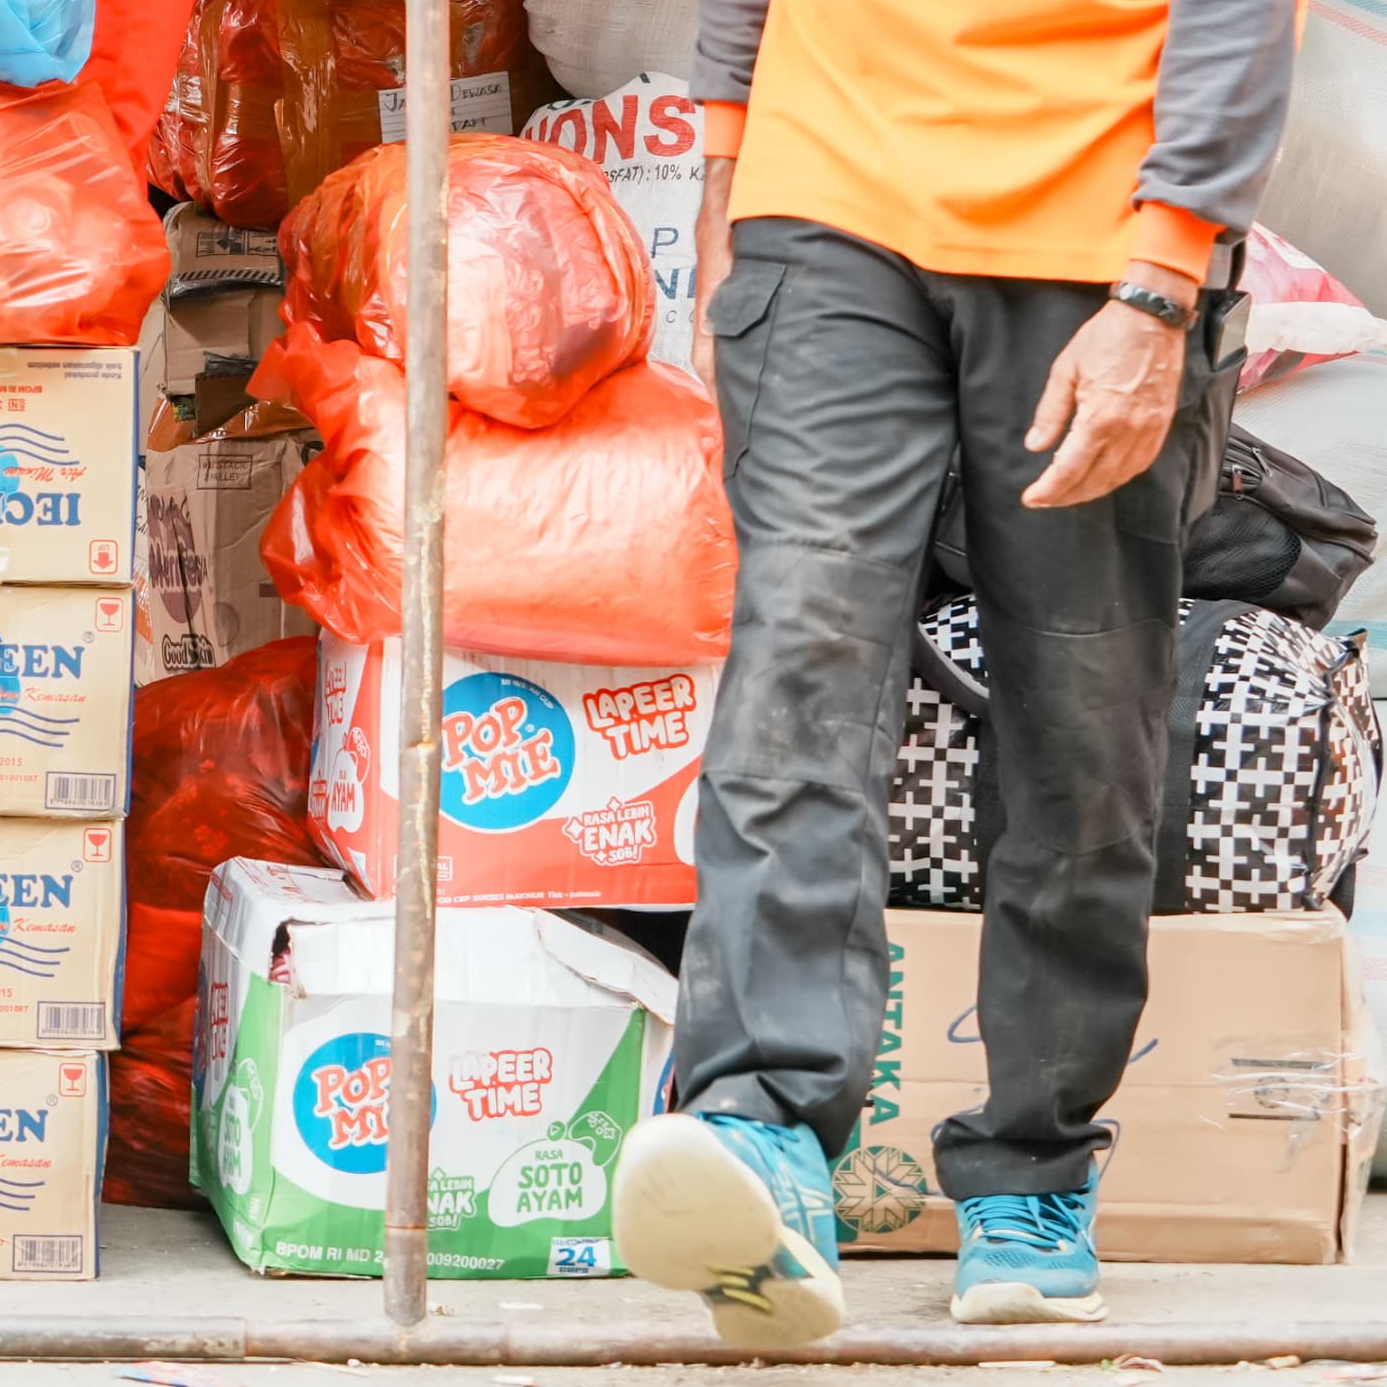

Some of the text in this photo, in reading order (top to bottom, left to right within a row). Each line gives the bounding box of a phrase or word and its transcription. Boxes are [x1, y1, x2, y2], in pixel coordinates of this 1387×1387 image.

[585, 676, 694, 728] LAPEER
[442, 697, 526, 768] POP
[607, 714, 687, 757] TIME
[463, 731, 561, 805] MIE
[584, 806, 649, 825] RASA LEBIH
[585, 820, 651, 851] ENAK
[466, 1083, 542, 1118] TIME
[517, 1162, 583, 1189] SOTO
[517, 1187, 583, 1213] AYAM
[276, 1242, 369, 1262] BPOM RI MD
[553, 1247, 598, 1267] 24
